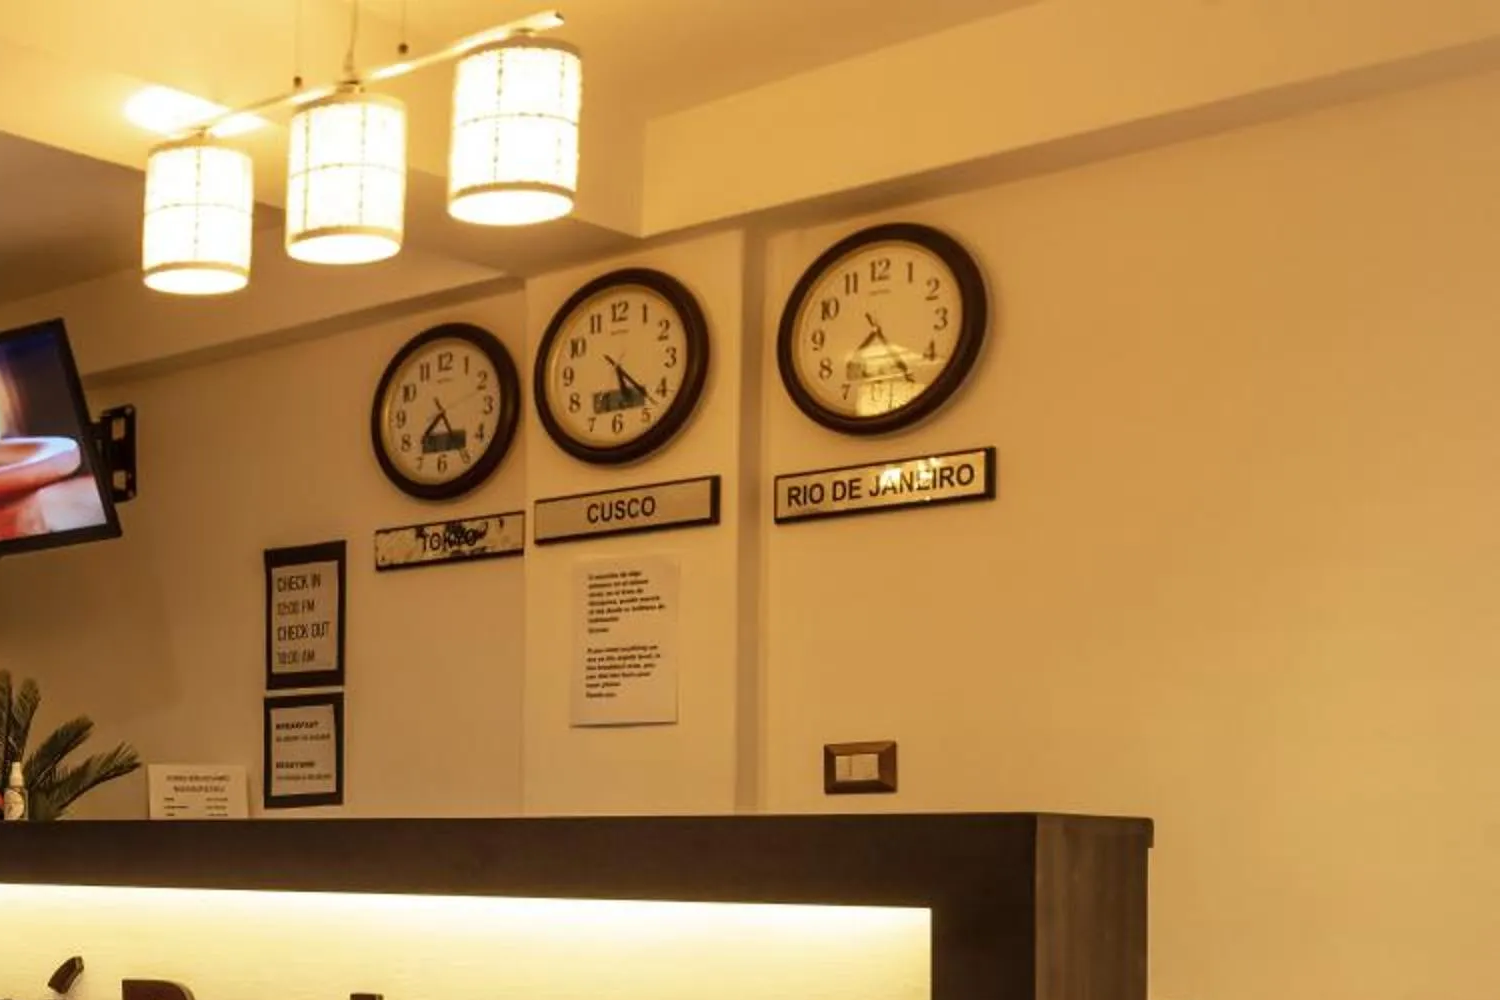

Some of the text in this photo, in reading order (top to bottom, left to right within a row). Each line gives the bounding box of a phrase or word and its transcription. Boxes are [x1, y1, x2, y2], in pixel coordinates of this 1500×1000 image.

[870, 258, 891, 282] 12
[905, 262, 913, 283] 1
[844, 272, 858, 294] 11
[925, 278, 940, 300] 2
[611, 301, 629, 322] 12
[641, 303, 649, 324] 1
[820, 299, 839, 321] 10
[934, 308, 948, 330] 3
[590, 314, 602, 335] 11
[657, 319, 670, 341] 2
[570, 338, 586, 359] 10
[812, 330, 824, 351] 9
[438, 351, 453, 372] 12
[463, 356, 470, 375] 1
[665, 347, 677, 368] 3
[818, 357, 832, 379] 8
[420, 362, 430, 382] 11
[476, 370, 488, 391] 2
[563, 366, 574, 387] 9
[403, 383, 417, 404] 10
[656, 377, 668, 398] 4
[483, 394, 493, 415] 3
[569, 393, 581, 413] 8
[396, 410, 406, 430] 9
[612, 413, 624, 433] 6
[401, 434, 411, 451] 8
[475, 424, 485, 441] 4
[437, 455, 448, 472] 6
[787, 463, 975, 507] RIO DE JANEIRO
[587, 496, 656, 524] CUSCO
